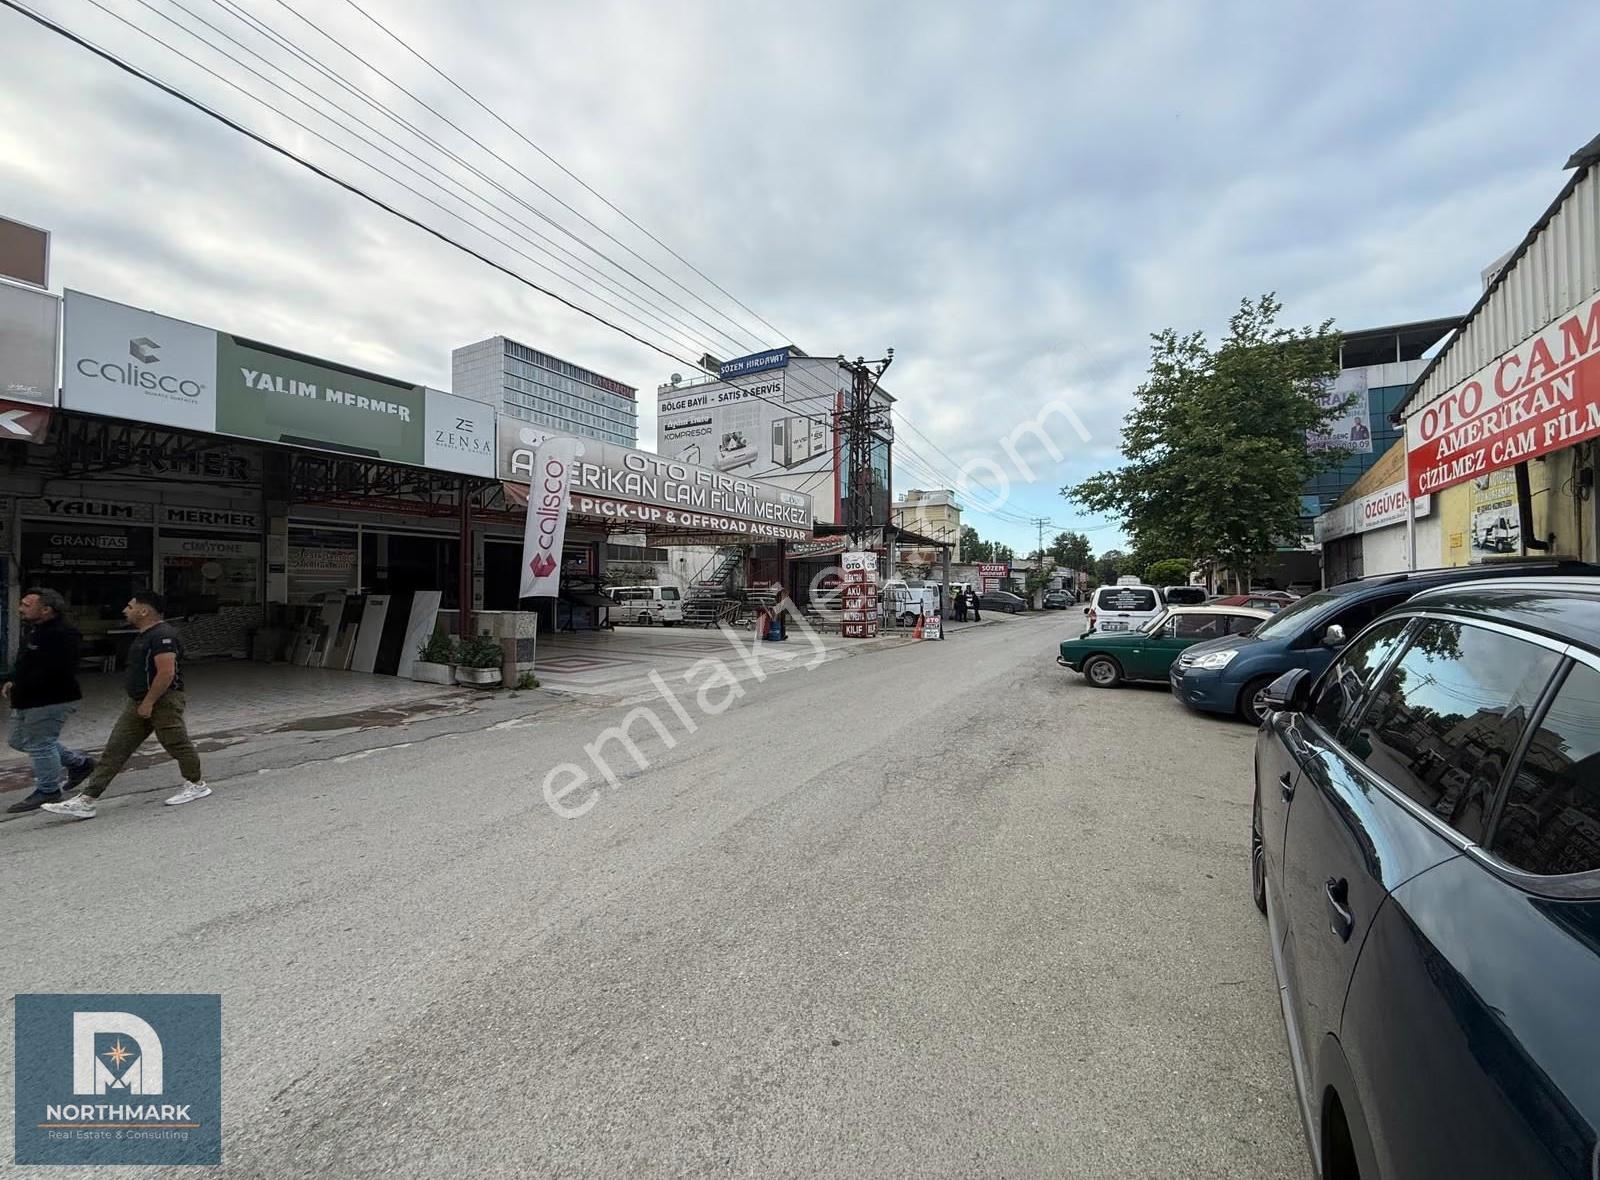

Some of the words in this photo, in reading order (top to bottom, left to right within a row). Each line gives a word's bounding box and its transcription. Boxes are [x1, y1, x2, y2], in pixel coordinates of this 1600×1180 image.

[77, 358, 201, 397] calisco
[1420, 380, 1483, 441] OTO
[1494, 300, 1600, 399] CAM
[240, 367, 317, 399] YALIM
[325, 388, 411, 422] MERMER
[661, 400, 686, 412] BÖLGE
[742, 390, 748, 398] &
[750, 382, 781, 397] SERVİS
[436, 430, 490, 452] ZENSA
[1419, 448, 1486, 492] ÇİZİLMEZ
[1491, 428, 1536, 464] CAM
[511, 449, 657, 499] AERİKAN
[664, 480, 706, 507] CAM
[624, 453, 687, 482] OTO
[696, 470, 760, 498] FIRAT
[43, 498, 133, 518] YALIM
[167, 508, 256, 527] MERMER
[536, 460, 564, 550] calisco
[666, 510, 676, 523] &
[680, 513, 747, 532] OFFROAD
[750, 523, 806, 541] AKSESUAR
[846, 562, 860, 570] OTO
